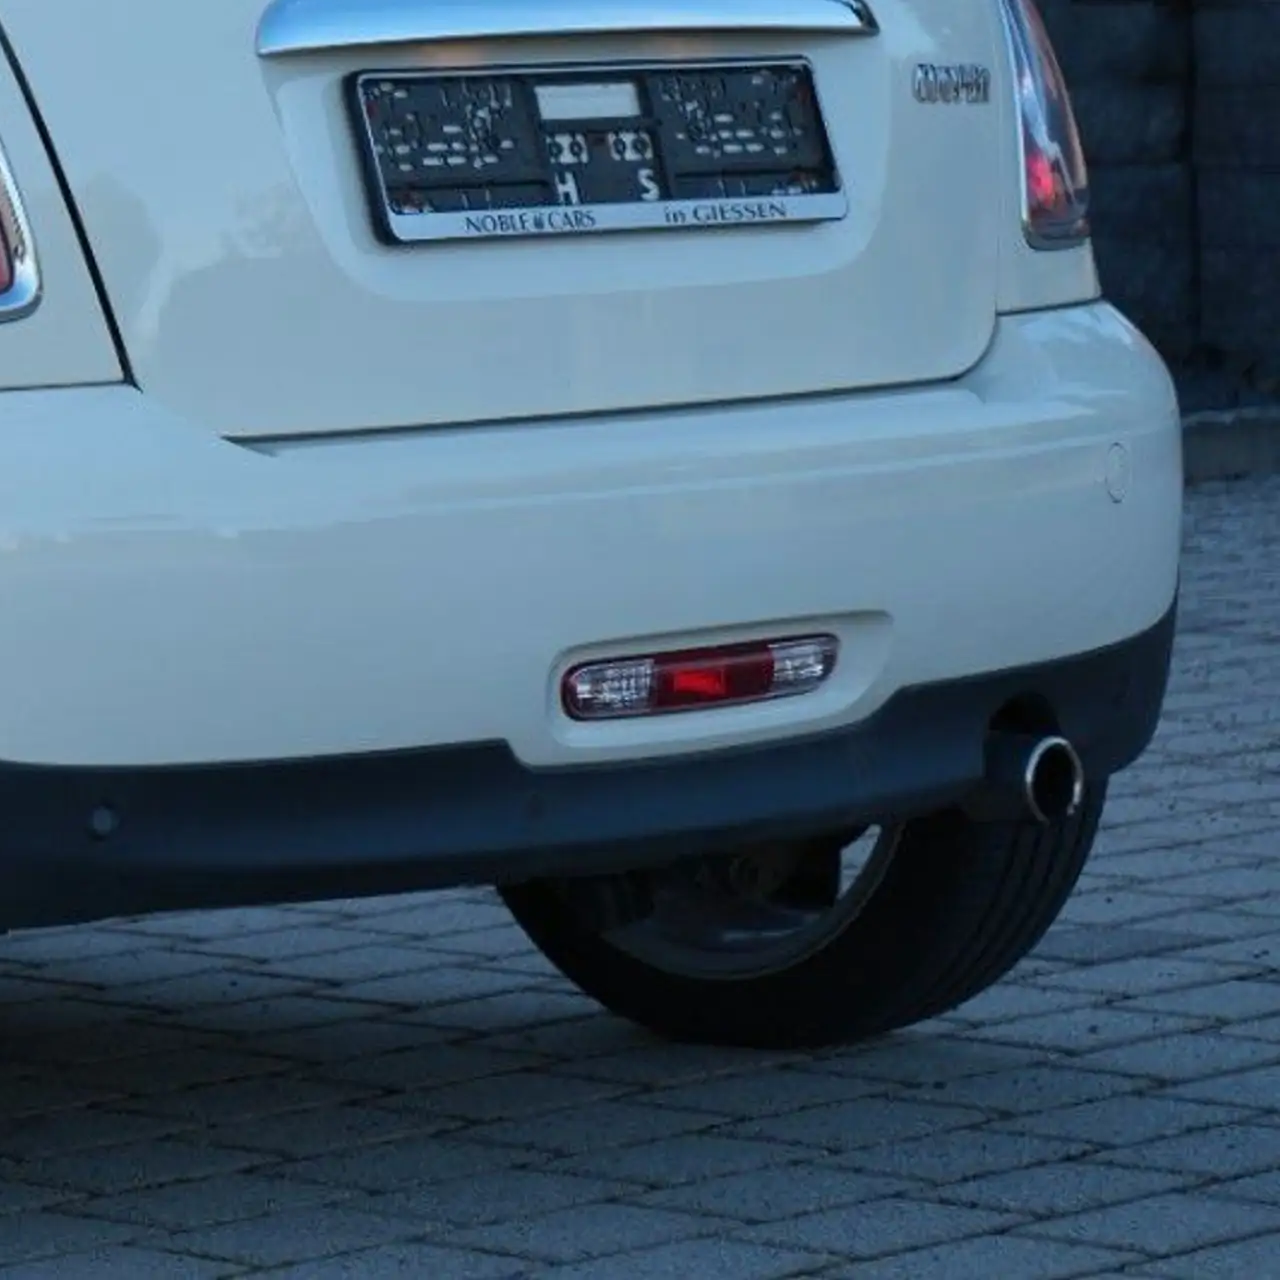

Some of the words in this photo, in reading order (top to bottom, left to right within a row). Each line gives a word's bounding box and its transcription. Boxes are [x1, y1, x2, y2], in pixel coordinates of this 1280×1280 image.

[465, 212, 531, 234] NOBLE
[548, 210, 597, 231] CARS
[693, 200, 788, 222] GIESSEN
